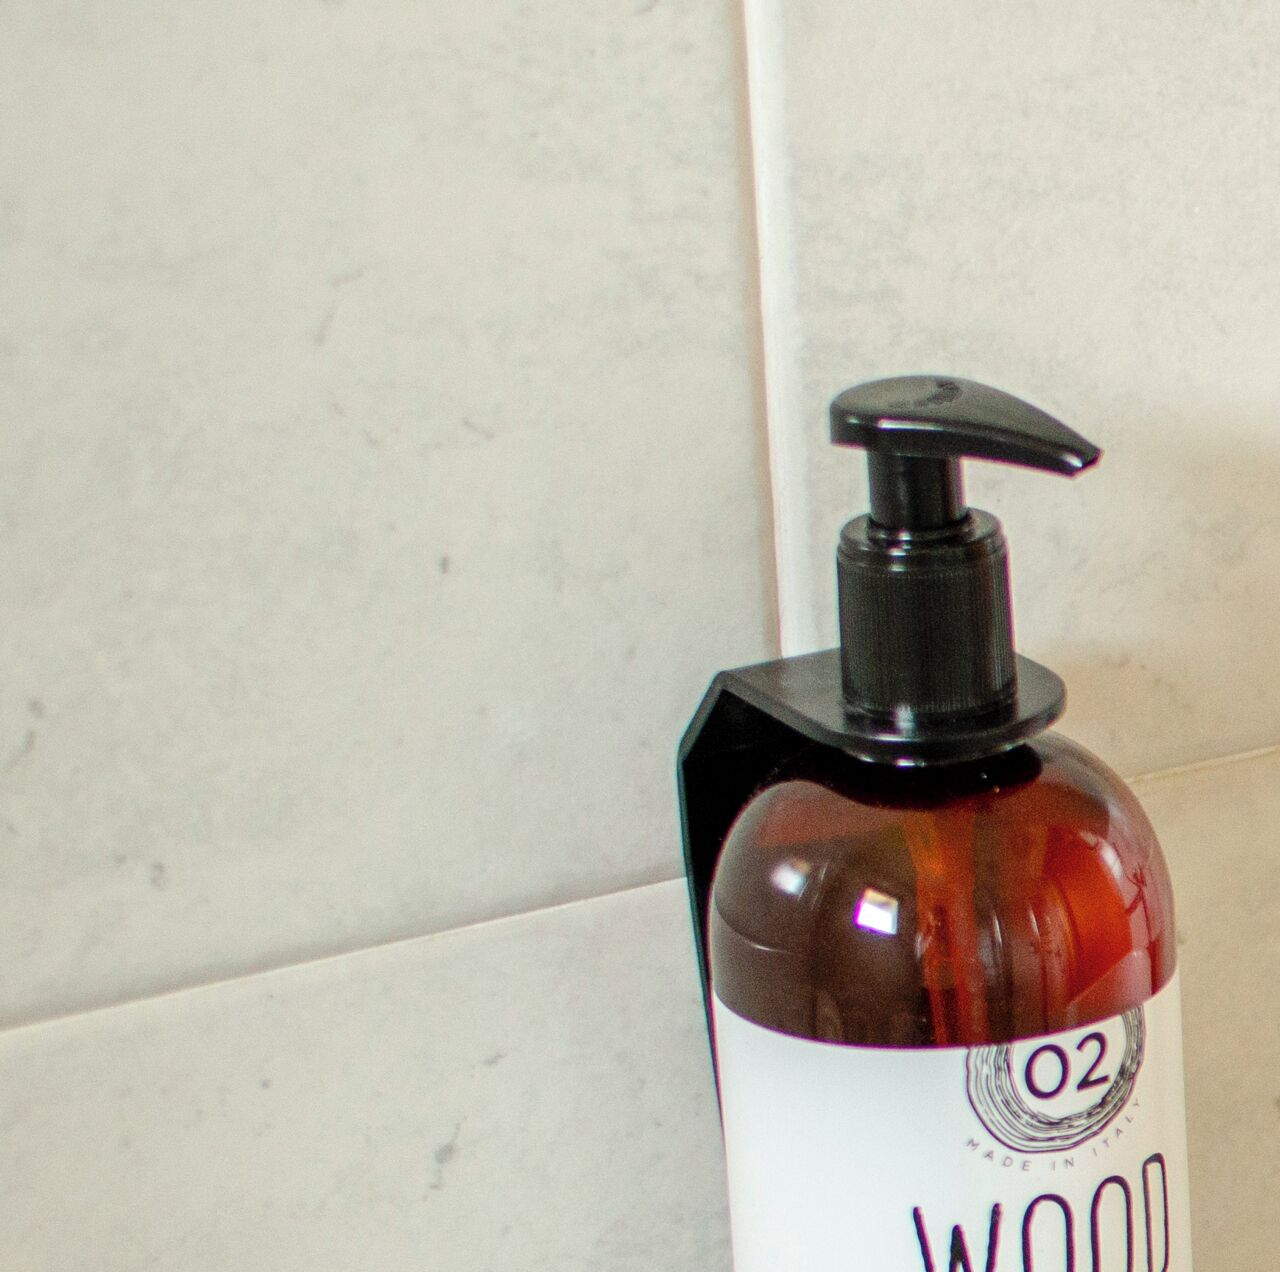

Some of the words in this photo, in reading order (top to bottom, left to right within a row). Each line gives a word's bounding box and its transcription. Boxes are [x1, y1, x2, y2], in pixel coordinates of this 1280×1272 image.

[965, 1136, 1032, 1171] MADE
[1051, 1157, 1075, 1171] IN
[1092, 1098, 1140, 1157] ITALY
